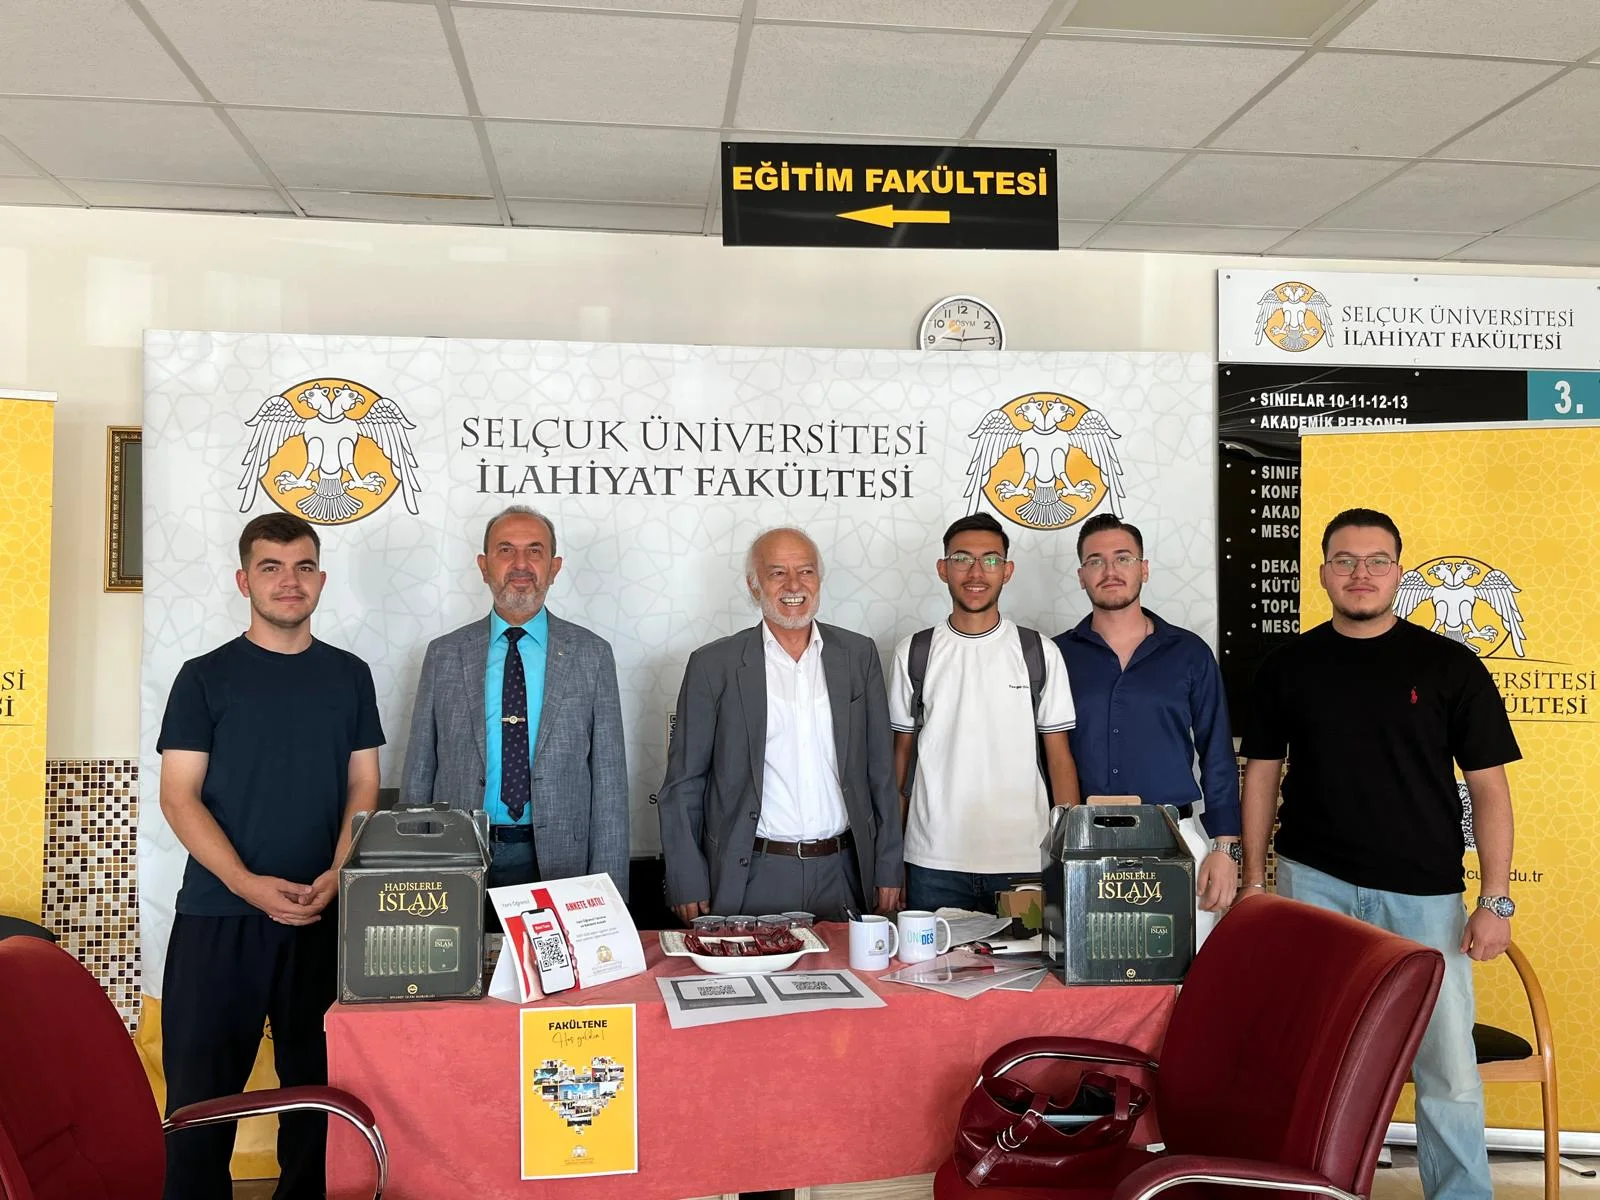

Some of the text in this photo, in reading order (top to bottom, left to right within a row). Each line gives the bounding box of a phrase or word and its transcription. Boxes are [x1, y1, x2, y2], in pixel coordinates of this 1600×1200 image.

[732, 161, 1047, 196] EĞİTİM FAKÜLTESİ
[945, 309, 951, 318] 11
[958, 305, 968, 315] 12
[1341, 305, 1575, 327] SELÇUK ÜNİVERSİTESİ
[934, 319, 945, 328] 10
[984, 321, 991, 329] 2
[928, 335, 936, 344] 9
[988, 336, 996, 345] 3
[1343, 326, 1562, 351] İLAHİYAT FAKÜLTESİ
[1260, 392, 1408, 410] SINIFLAR 10-11-12-13
[1554, 380, 1584, 415] 3.
[1260, 413, 1334, 429] AKADEMİK
[461, 415, 928, 458] SELÇUK ÜNİVERSİTESİ
[476, 457, 914, 501] İLAHİYAT FAKÜLTESİ
[1261, 465, 1300, 480] SINIF
[1261, 484, 1300, 499] KONF
[1261, 504, 1300, 519] AKAD
[1261, 524, 1300, 539] MESC
[1261, 559, 1300, 573] DEKA
[1261, 576, 1300, 593] KÜTÜ
[1261, 599, 1300, 614] TOPL
[1262, 619, 1300, 634] MESC
[1, 669, 26, 691] Sİ
[1490, 669, 1597, 691] ERSİTESİ
[1502, 693, 1588, 715] ÜLTESİ
[648, 794, 658, 805] S
[1103, 871, 1157, 881] HADİSLERLE
[384, 881, 443, 892] HADİSLERLE
[1097, 879, 1163, 905] İSLAM
[378, 890, 449, 917] İSLAM
[565, 900, 588, 912] ANKETE
[548, 1019, 608, 1031] FAKÜLTENE
